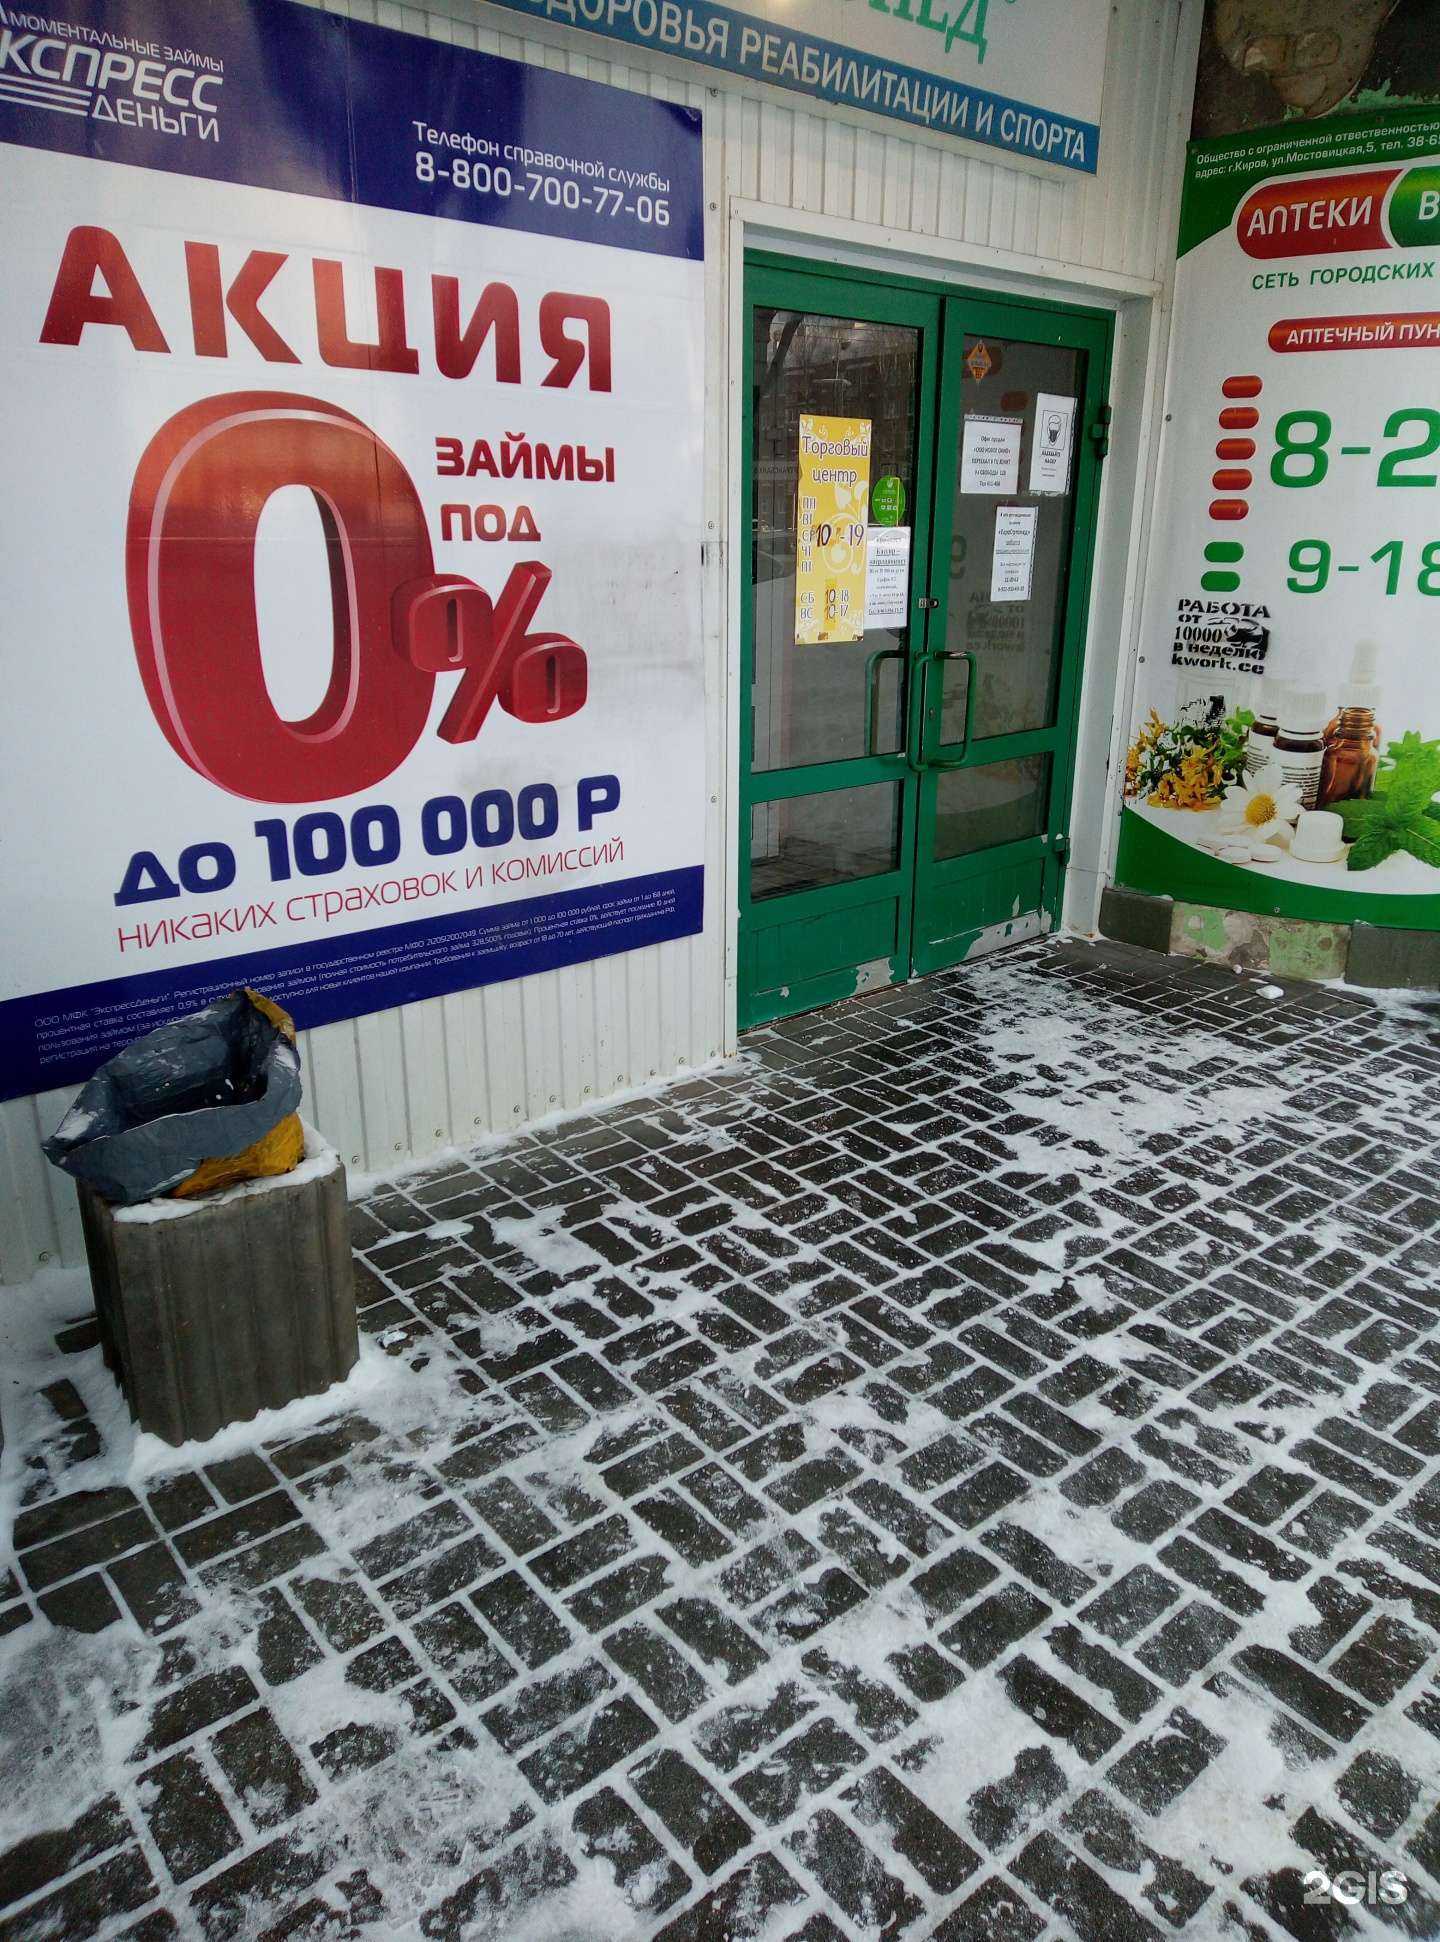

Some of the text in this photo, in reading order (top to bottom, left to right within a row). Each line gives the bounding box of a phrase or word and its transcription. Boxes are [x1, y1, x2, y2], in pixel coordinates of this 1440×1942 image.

[9, 11, 224, 73] МОМЕНТАЛЬНЫЕ ЗАЙМЫ
[739, 27, 970, 128] РЕАБИЛИТАЦИИ
[975, 101, 994, 135] И
[1001, 109, 1085, 162] СПОРТА
[92, 95, 220, 142] ДЕНЬГИ
[412, 121, 670, 192] Телефон справочной службы
[1197, 149, 1246, 166] Общество
[1256, 133, 1333, 155] ограниченной
[1407, 134, 1440, 148] 38-6
[415, 151, 670, 226] 8-800-700-77-06
[1247, 196, 1373, 237] АПТЕКИ
[1252, 262, 1435, 290] СЕТЬ ГОРОДСКИХ
[39, 225, 612, 393] АКЦИЯ
[1286, 322, 1394, 346] АПТЕЧНЫЙ
[434, 431, 616, 483] ЗАЙМЫ
[802, 436, 868, 459] Торговый
[813, 469, 857, 487] центр
[440, 503, 541, 542] ПОД
[1178, 599, 1271, 618] РАБОТА
[1175, 626, 1223, 642] 10000
[254, 805, 401, 881] 100
[421, 783, 558, 856] 000
[577, 774, 620, 832] Р
